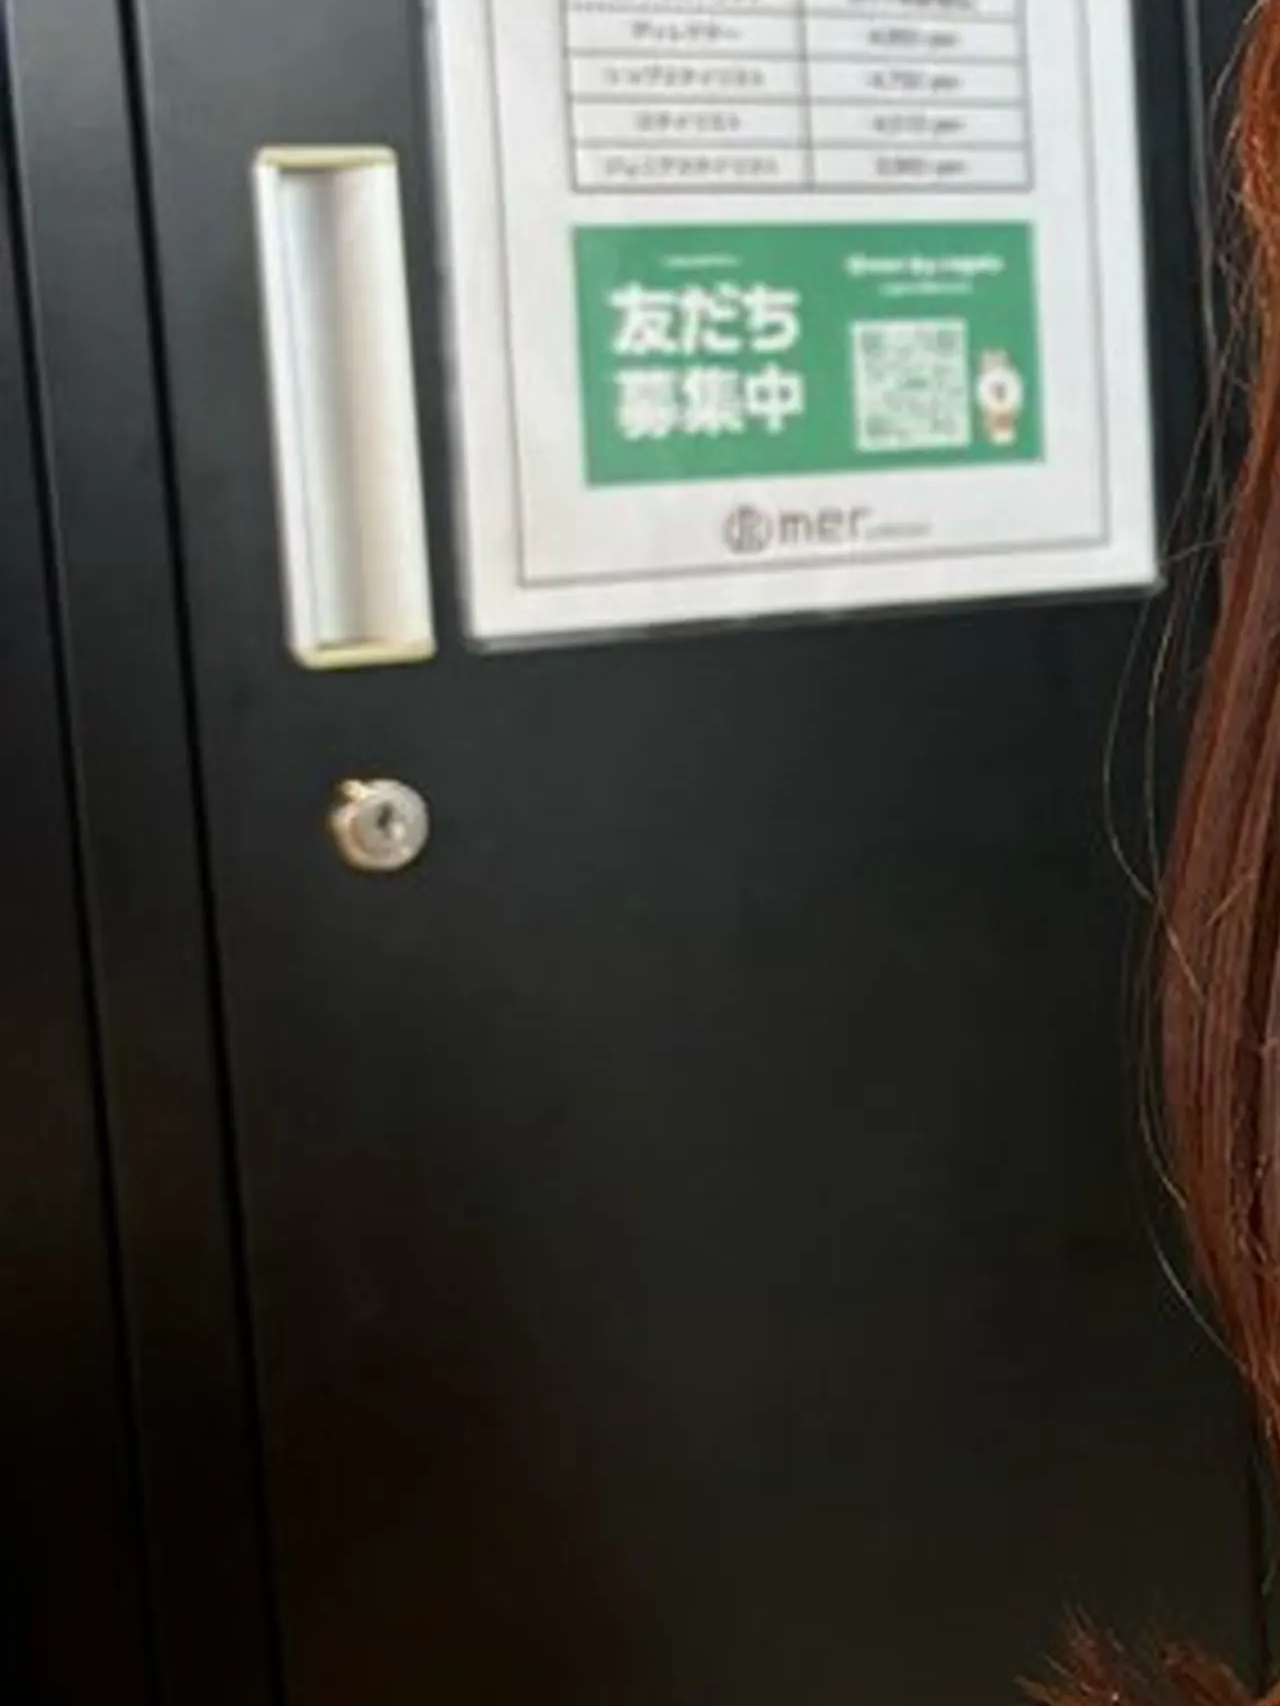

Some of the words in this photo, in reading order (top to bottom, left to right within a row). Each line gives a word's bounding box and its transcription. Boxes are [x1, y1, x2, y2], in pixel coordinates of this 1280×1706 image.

[609, 280, 802, 356] 友だち
[613, 360, 806, 441] 募集中
